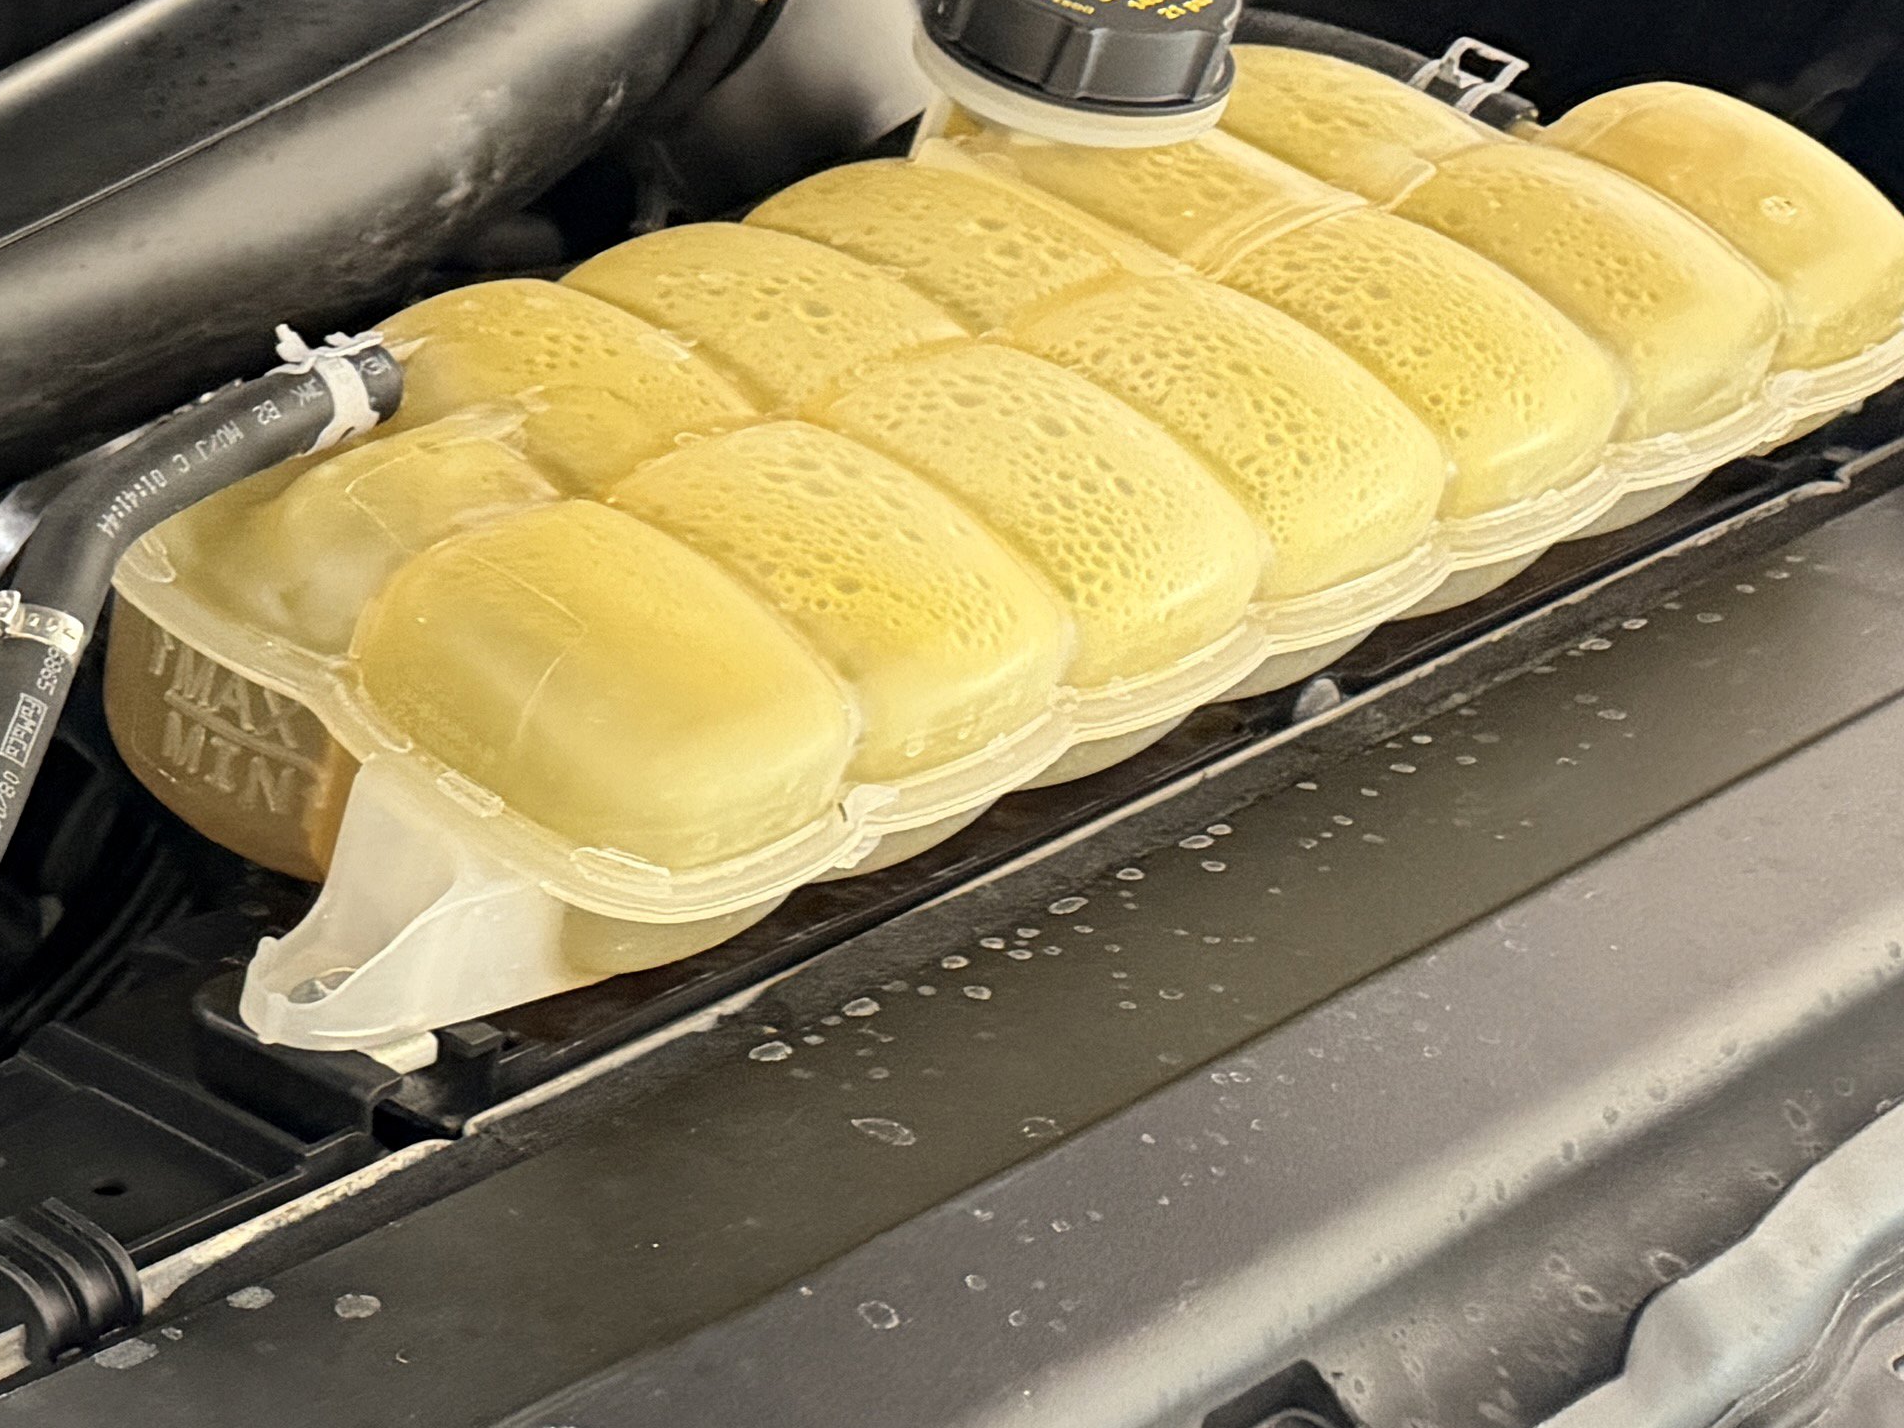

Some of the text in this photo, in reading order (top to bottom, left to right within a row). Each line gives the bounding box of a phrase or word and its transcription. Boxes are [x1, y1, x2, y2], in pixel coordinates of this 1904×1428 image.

[252, 398, 282, 426] B2
[172, 452, 191, 474] C
[96, 468, 168, 540] 01:41:44
[3, 696, 44, 763] FoMoCo
[172, 642, 300, 750] MAX
[161, 711, 298, 815] MIN
